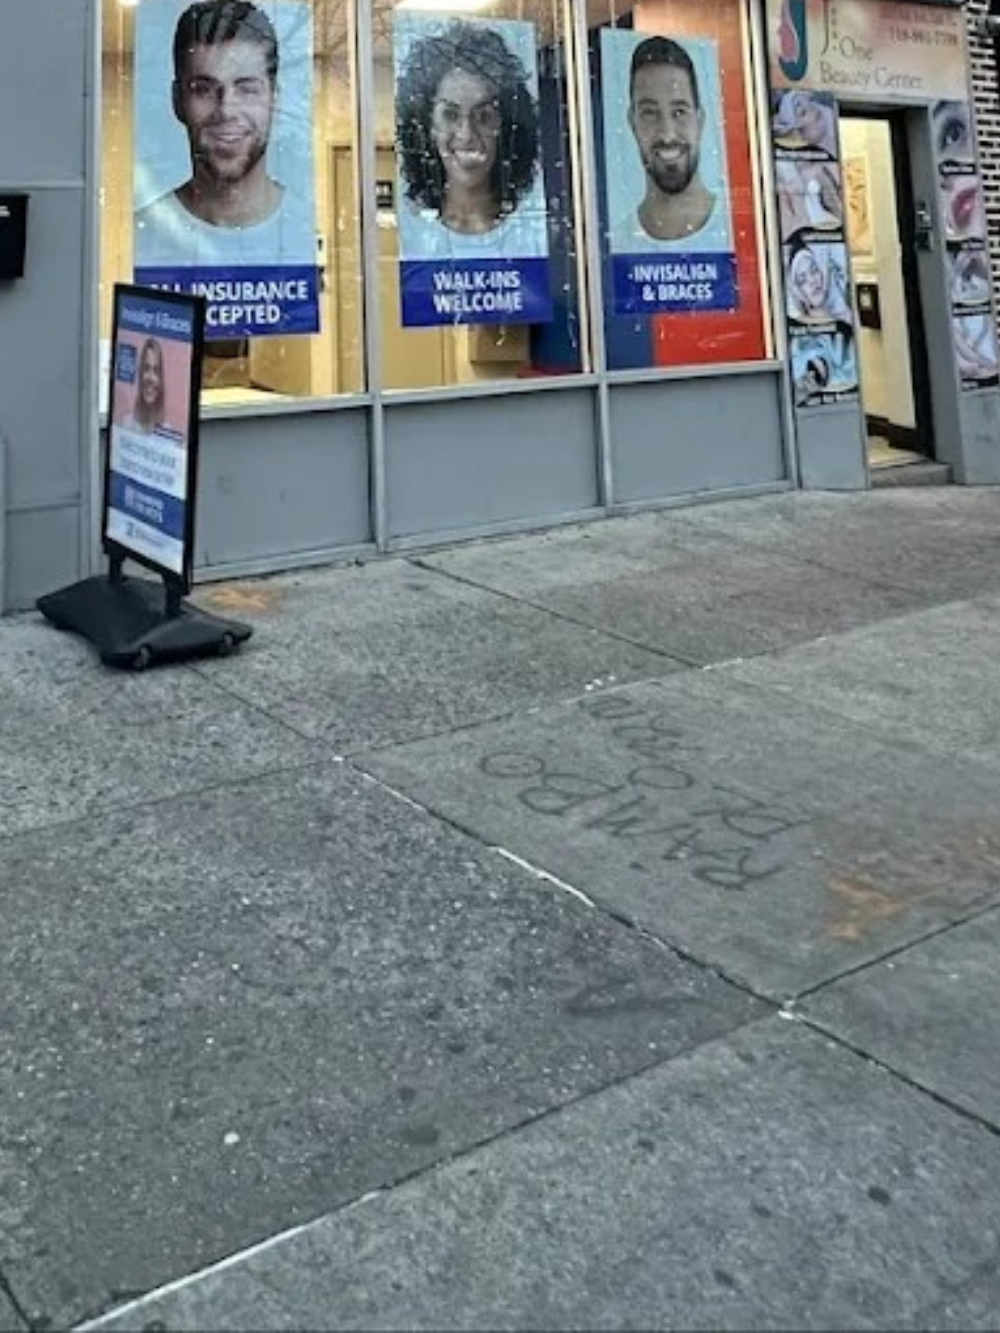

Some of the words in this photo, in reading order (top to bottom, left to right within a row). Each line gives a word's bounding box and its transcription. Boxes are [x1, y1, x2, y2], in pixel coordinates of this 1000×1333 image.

[820, 61, 871, 86] Beauty
[875, 67, 923, 89] Center
[433, 270, 521, 291] WALK-INS
[634, 263, 718, 283] INVISALIGN
[433, 291, 523, 314] WELCOME
[642, 283, 657, 302] &
[658, 282, 714, 302] BRACES
[205, 304, 281, 325] CEPTED
